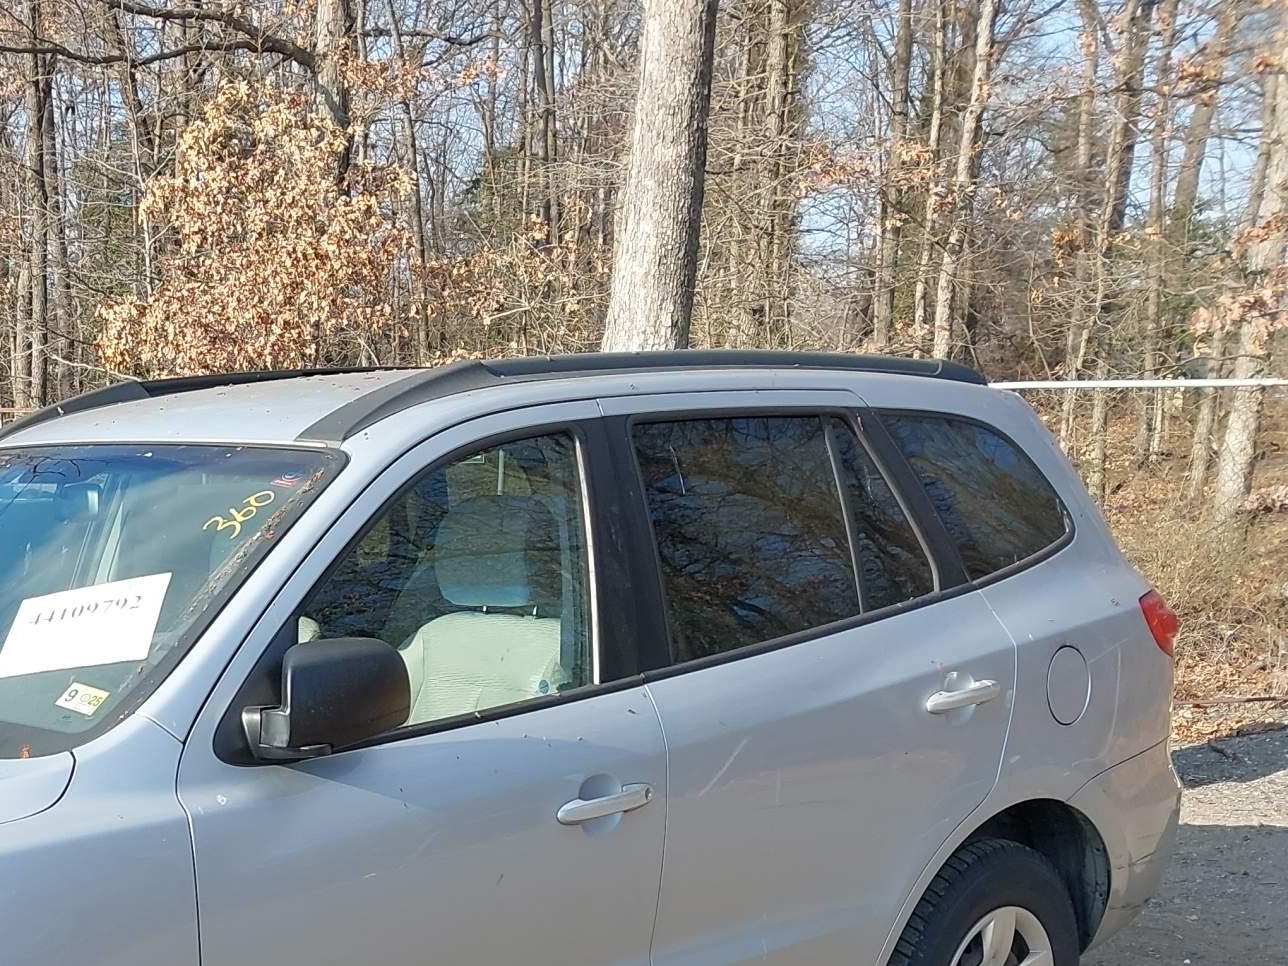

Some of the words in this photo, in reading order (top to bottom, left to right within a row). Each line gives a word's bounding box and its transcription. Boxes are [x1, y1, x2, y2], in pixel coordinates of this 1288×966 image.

[201, 489, 276, 540] 360
[29, 595, 142, 625] 44109792
[64, 688, 79, 702] 9
